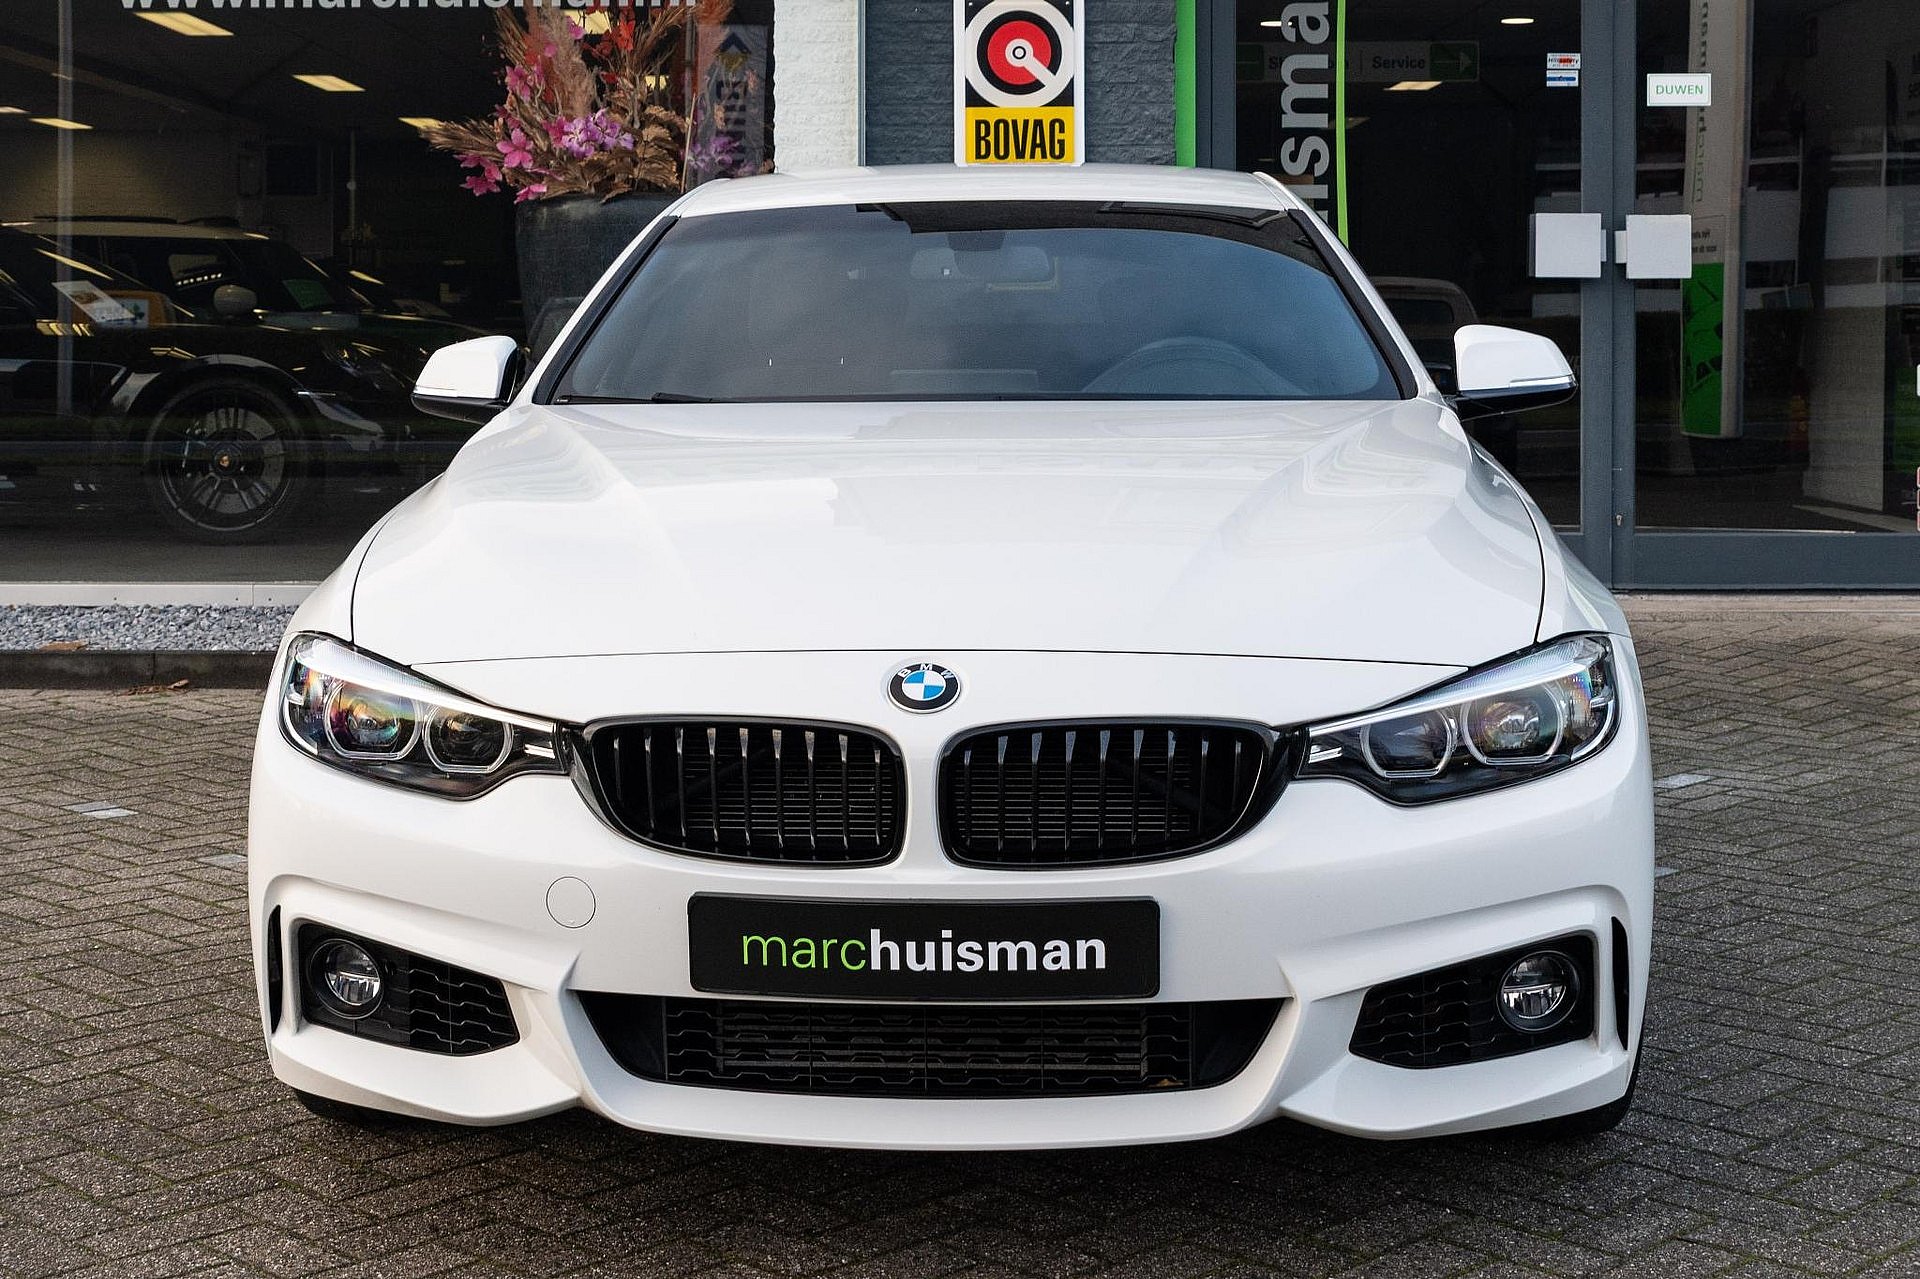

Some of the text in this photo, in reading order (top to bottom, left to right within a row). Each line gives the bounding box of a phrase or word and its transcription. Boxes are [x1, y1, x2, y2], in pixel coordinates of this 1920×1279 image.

[1372, 55, 1425, 69] Service
[1655, 84, 1703, 95] DUWEN
[974, 118, 1066, 161] BOVAG
[898, 663, 955, 679] BMW
[741, 928, 1107, 972] marchuisman
